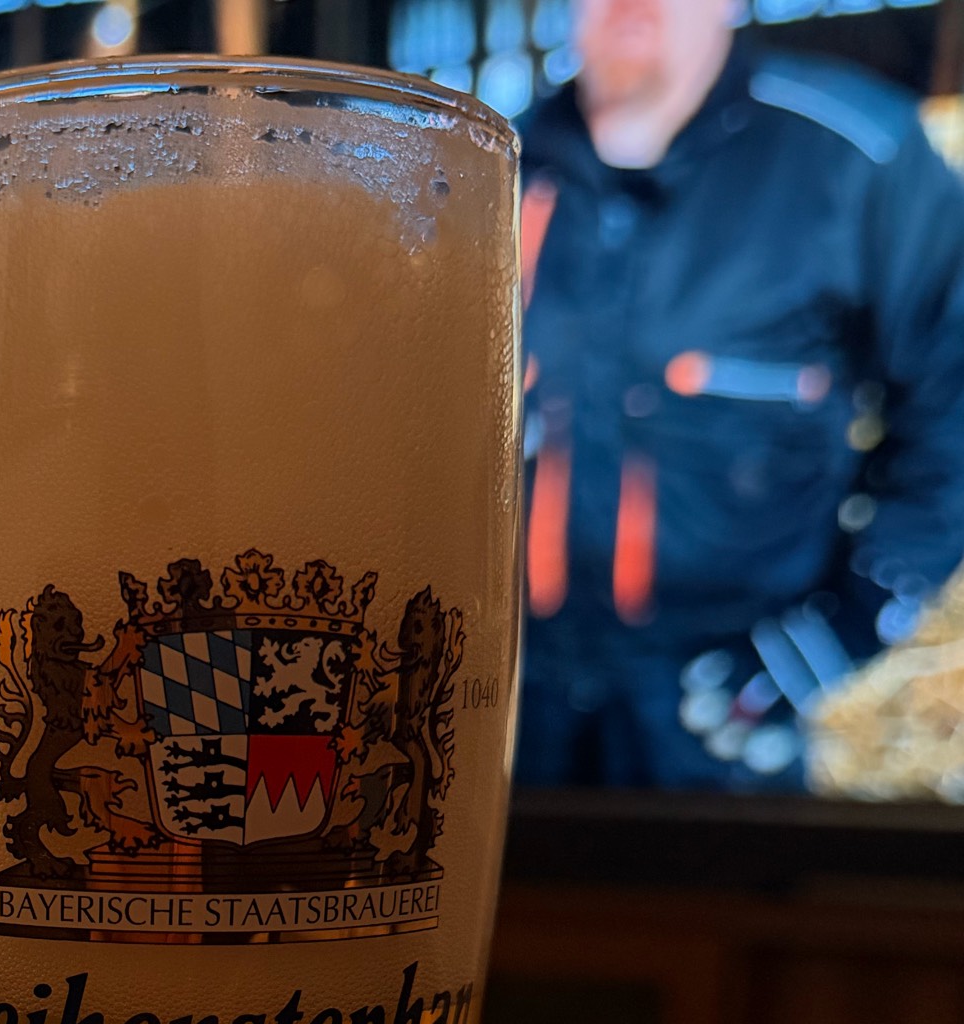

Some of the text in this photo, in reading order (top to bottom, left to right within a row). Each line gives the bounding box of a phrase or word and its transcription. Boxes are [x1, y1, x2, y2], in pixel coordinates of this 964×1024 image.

[461, 678, 500, 710] 1040
[0, 885, 441, 928] BAYERISCHE STAATSBRAUEREI
